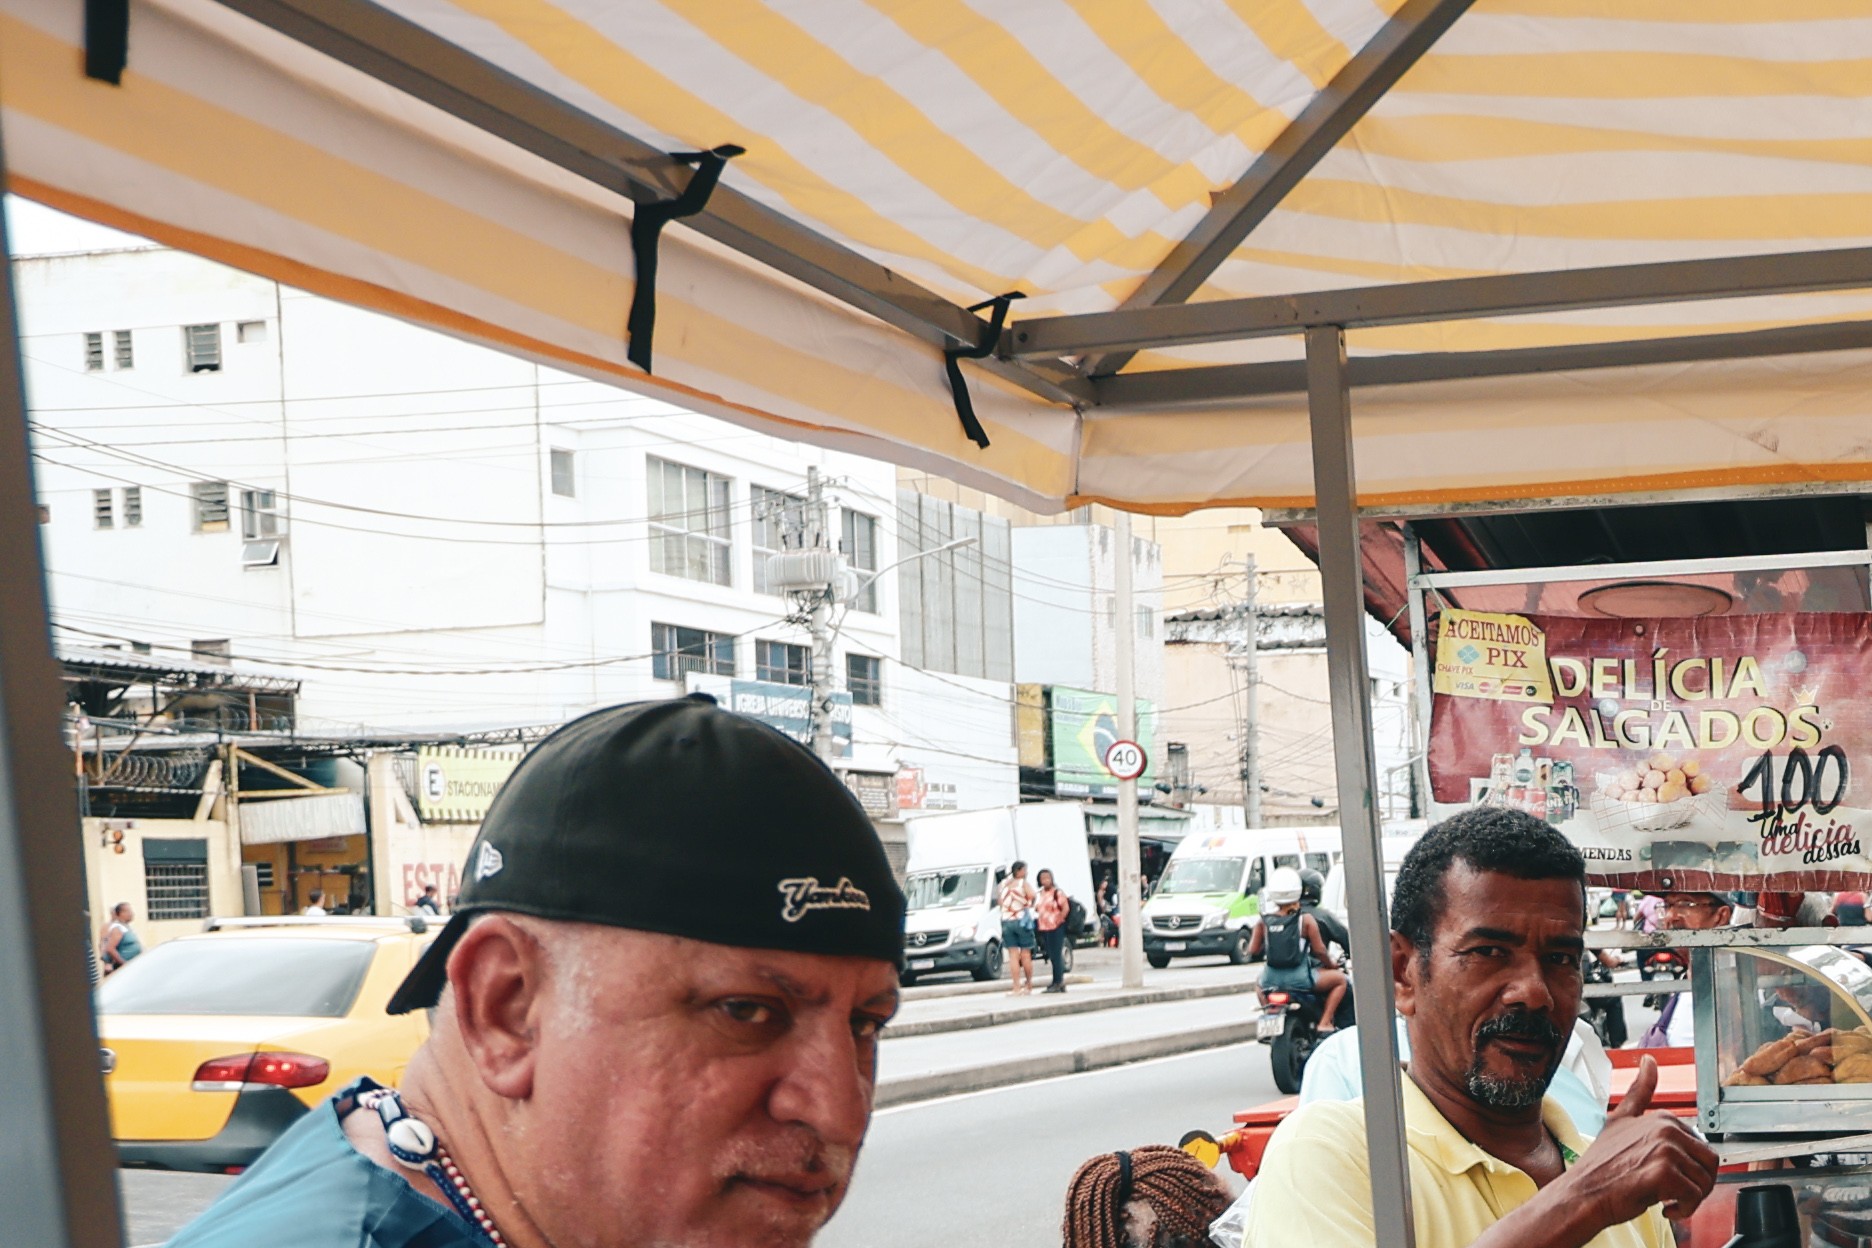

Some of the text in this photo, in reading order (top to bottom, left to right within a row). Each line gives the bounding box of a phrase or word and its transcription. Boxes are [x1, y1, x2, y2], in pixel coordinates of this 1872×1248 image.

[1444, 619, 1539, 647] ACEITAMOS
[1486, 647, 1528, 669] PIX
[1455, 682, 1475, 690] VISA
[1549, 648, 1770, 701] DELÍCIA
[1651, 700, 1671, 712] DE
[1519, 704, 1824, 750] SALGADOS
[1112, 749, 1138, 766] 40
[1737, 744, 1849, 815] 100
